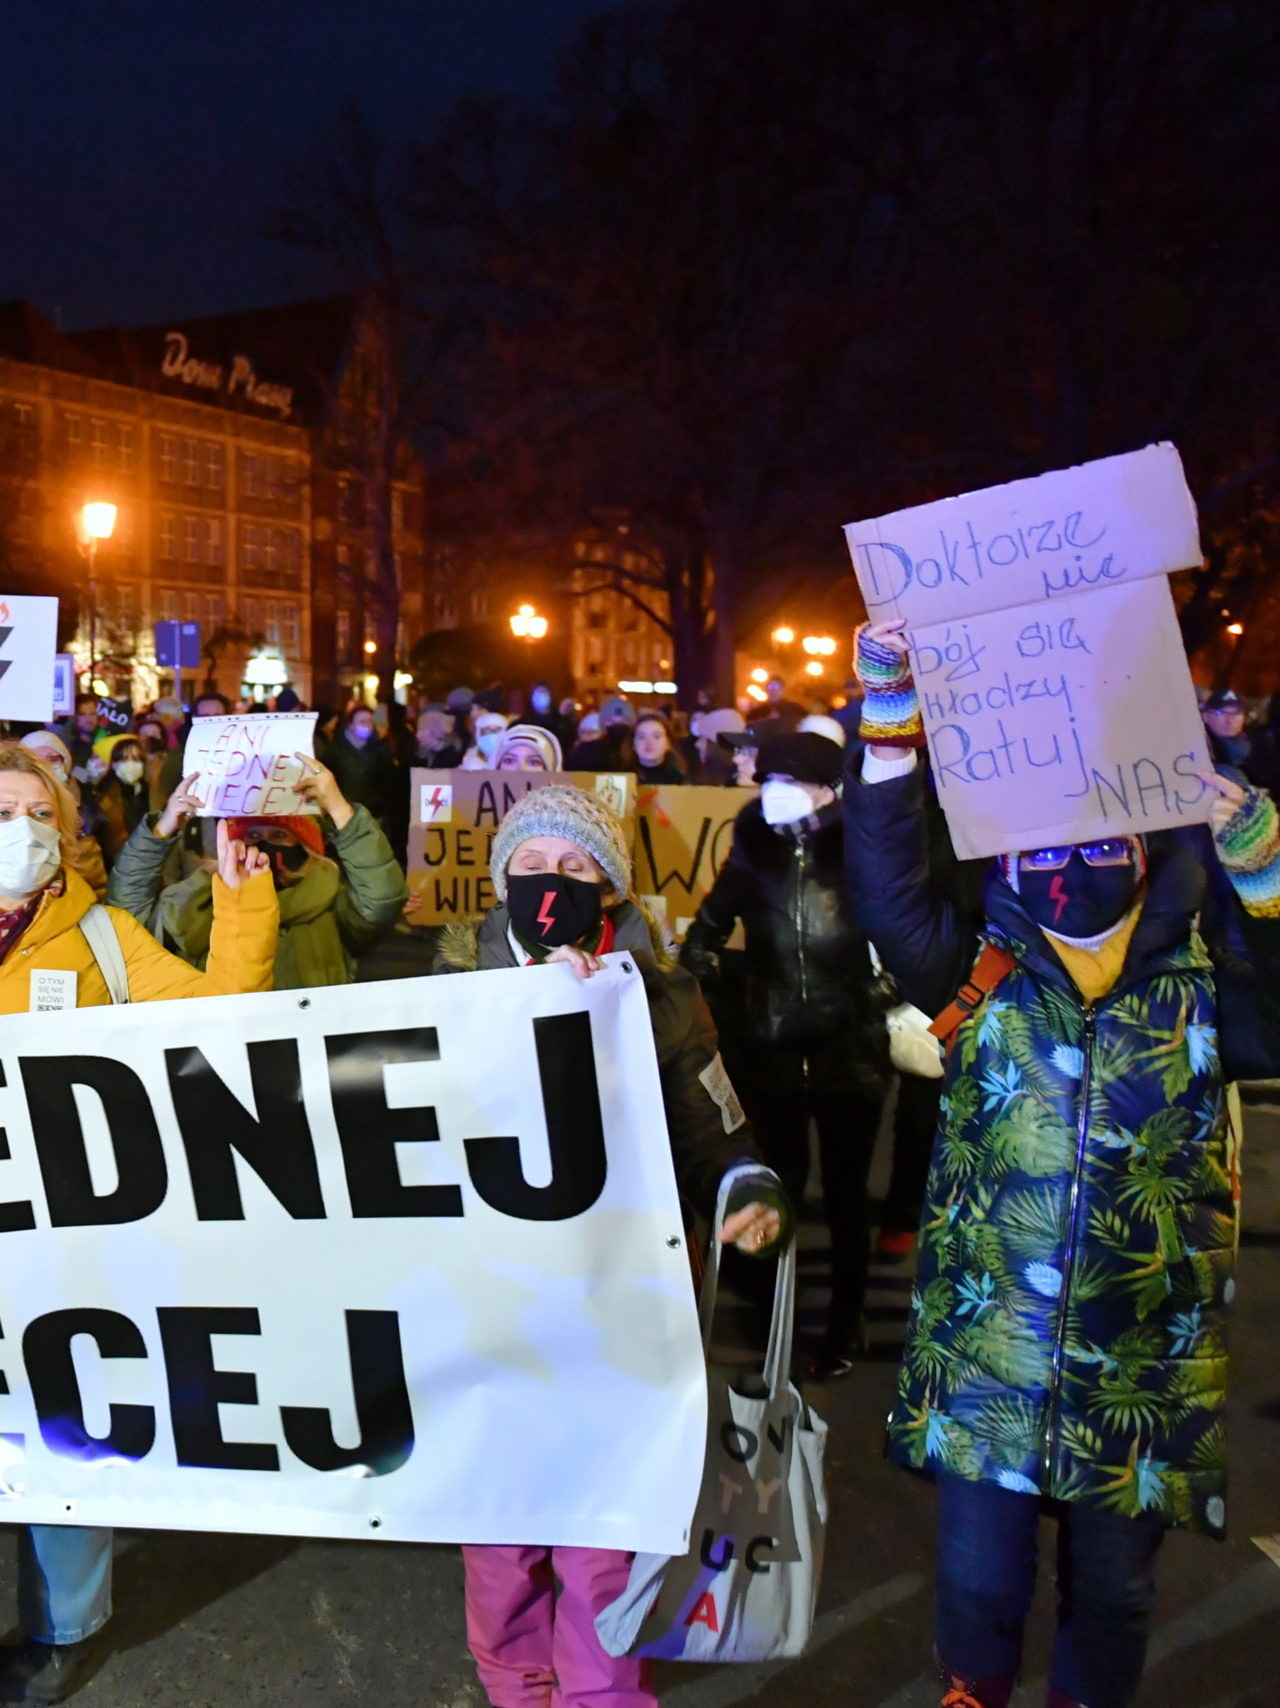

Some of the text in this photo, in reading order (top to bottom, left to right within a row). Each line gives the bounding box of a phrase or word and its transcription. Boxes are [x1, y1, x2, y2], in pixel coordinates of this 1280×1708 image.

[217, 723, 270, 748] ANI
[930, 716, 1089, 797] Ratuj
[1092, 752, 1207, 823] NAS
